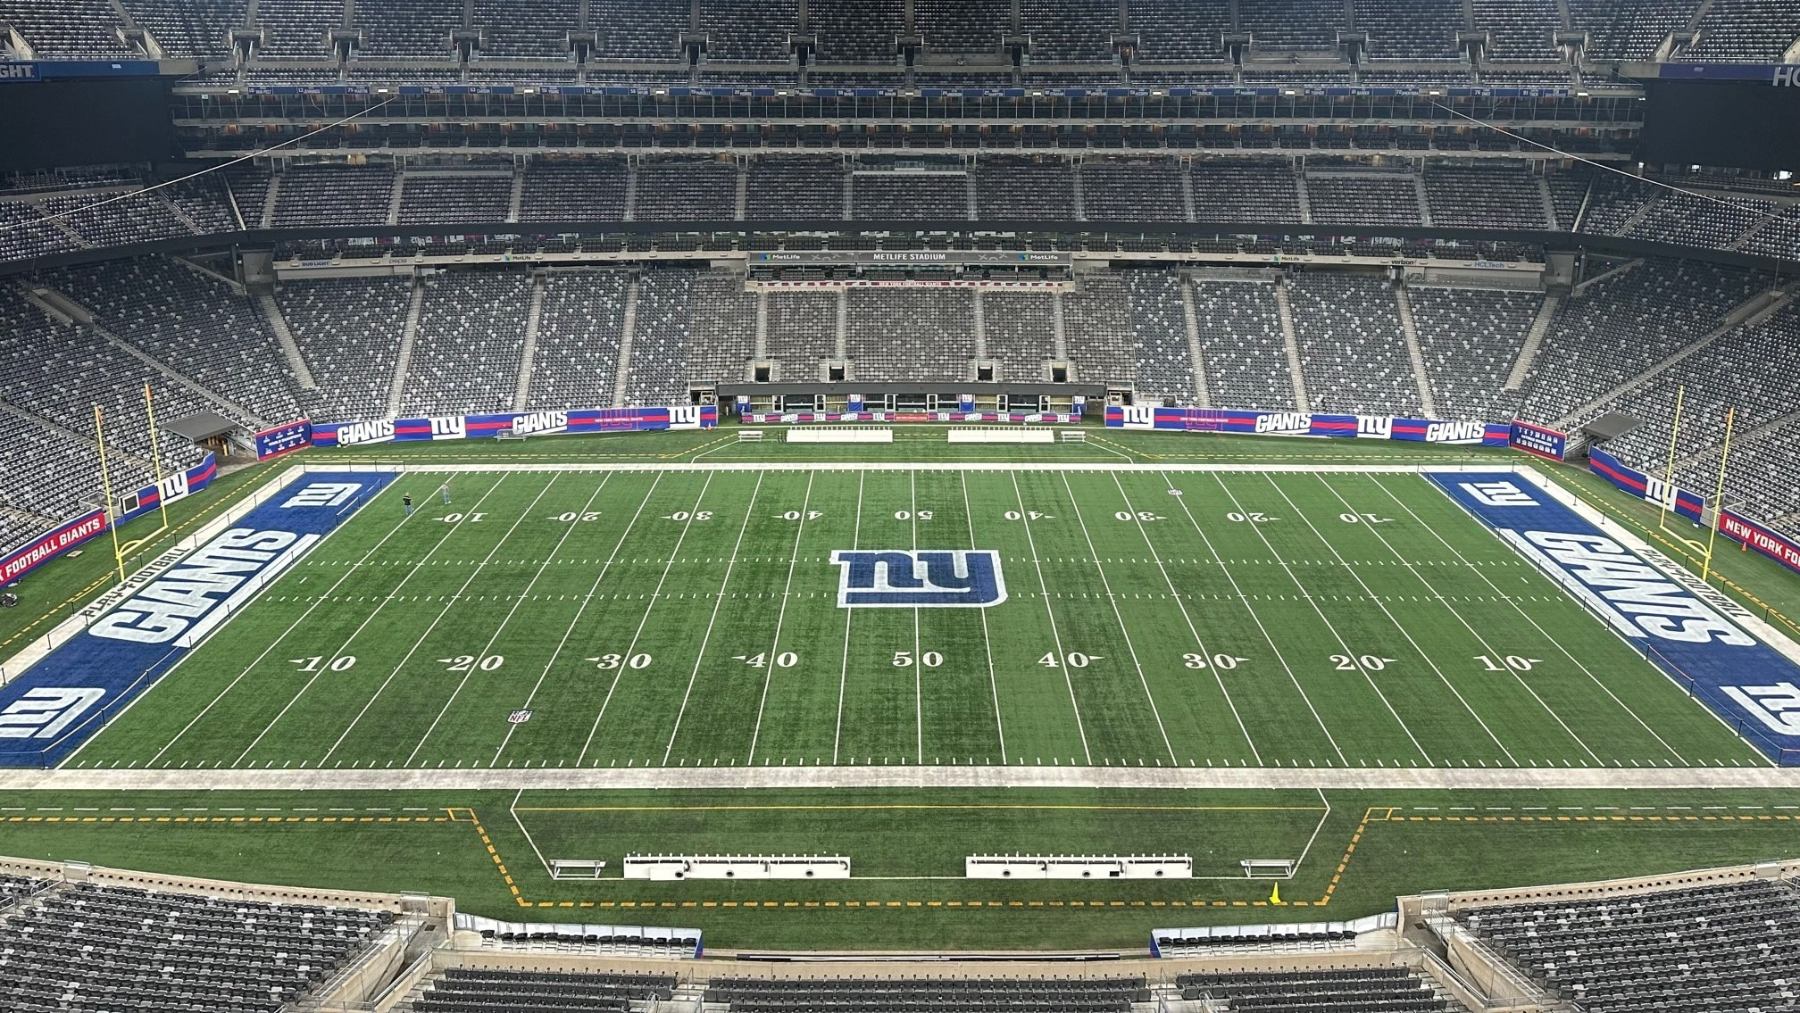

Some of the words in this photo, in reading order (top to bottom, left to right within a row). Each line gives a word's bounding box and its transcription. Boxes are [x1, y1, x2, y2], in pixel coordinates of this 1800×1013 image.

[873, 253, 908, 261] METLIFE
[910, 253, 946, 261] STADIUM
[512, 410, 568, 434] GIANTS
[1255, 412, 1313, 433] GIANTS
[337, 420, 395, 445] GIANTS
[1425, 420, 1486, 443] GIANTS
[443, 512, 489, 523] 10
[558, 511, 602, 522] 20
[671, 510, 713, 521] 30
[783, 510, 823, 520] 40
[894, 510, 934, 520] 50
[1004, 510, 1046, 520] 40
[1114, 511, 1156, 522] 30
[1226, 512, 1269, 523] 20
[1339, 512, 1384, 523] 10
[1725, 518, 1752, 539] NEW
[1753, 531, 1782, 557] YORK
[5, 541, 58, 578] FOOTBALL
[59, 518, 101, 547] GIANTS
[127, 548, 190, 589] FOOTBALL
[88, 528, 298, 644] GIANTS
[1523, 530, 1757, 647] GIANTS
[297, 655, 356, 672] 10
[446, 655, 504, 671] 20
[596, 653, 653, 670] 30
[746, 652, 798, 668] 40
[892, 652, 944, 667] 50
[1038, 652, 1091, 668] 40
[1182, 653, 1237, 670] 30
[1329, 654, 1386, 671] 20
[1473, 655, 1532, 672] 10
